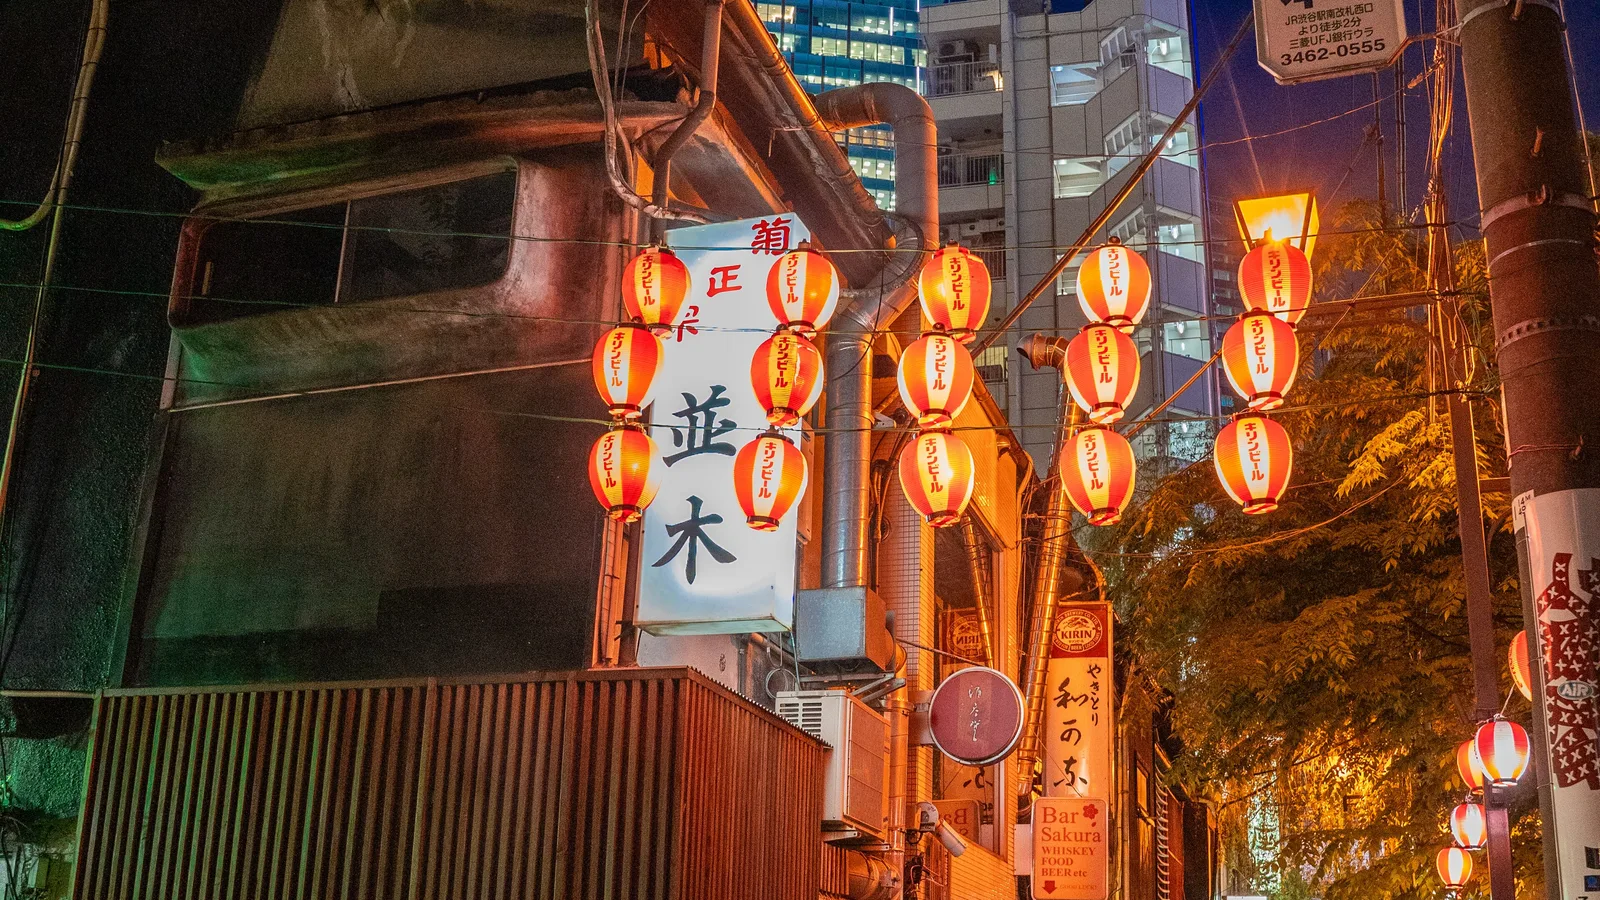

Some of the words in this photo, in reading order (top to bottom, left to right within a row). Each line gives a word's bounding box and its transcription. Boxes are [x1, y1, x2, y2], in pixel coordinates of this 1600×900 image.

[1285, 2, 1374, 26] JR渋谷駅南改札西口
[1289, 26, 1374, 50] 三菱UFJ銀行ウラ
[1298, 17, 1362, 36] より徒歩2分
[1280, 39, 1386, 66] 3462-0555
[642, 254, 656, 306] キリンビール
[786, 254, 799, 304] キリンビール
[950, 257, 966, 311] キリンビール
[1108, 248, 1123, 296] キリンビール
[1268, 250, 1286, 308] キリンビール
[611, 332, 626, 387] キリンビール
[775, 336, 791, 388] キリンビール
[933, 338, 947, 391] キリンビール
[1094, 330, 1113, 384] キリンビール
[1251, 320, 1269, 375] キリンビール
[602, 434, 616, 488] キリンビール
[758, 442, 777, 499] キリンビール
[925, 438, 944, 494] キリンビール
[1084, 434, 1104, 491] キリンビール
[1244, 422, 1264, 482] キリンビール
[651, 384, 738, 585] 並木
[1060, 630, 1092, 640] KIRIN
[1087, 664, 1102, 727] やきとり
[1042, 807, 1079, 824] Bar
[1042, 826, 1102, 842] Sakura
[1042, 846, 1096, 856] WHISKEY
[1042, 857, 1074, 866] FOOD
[1042, 868, 1072, 876] BEER
